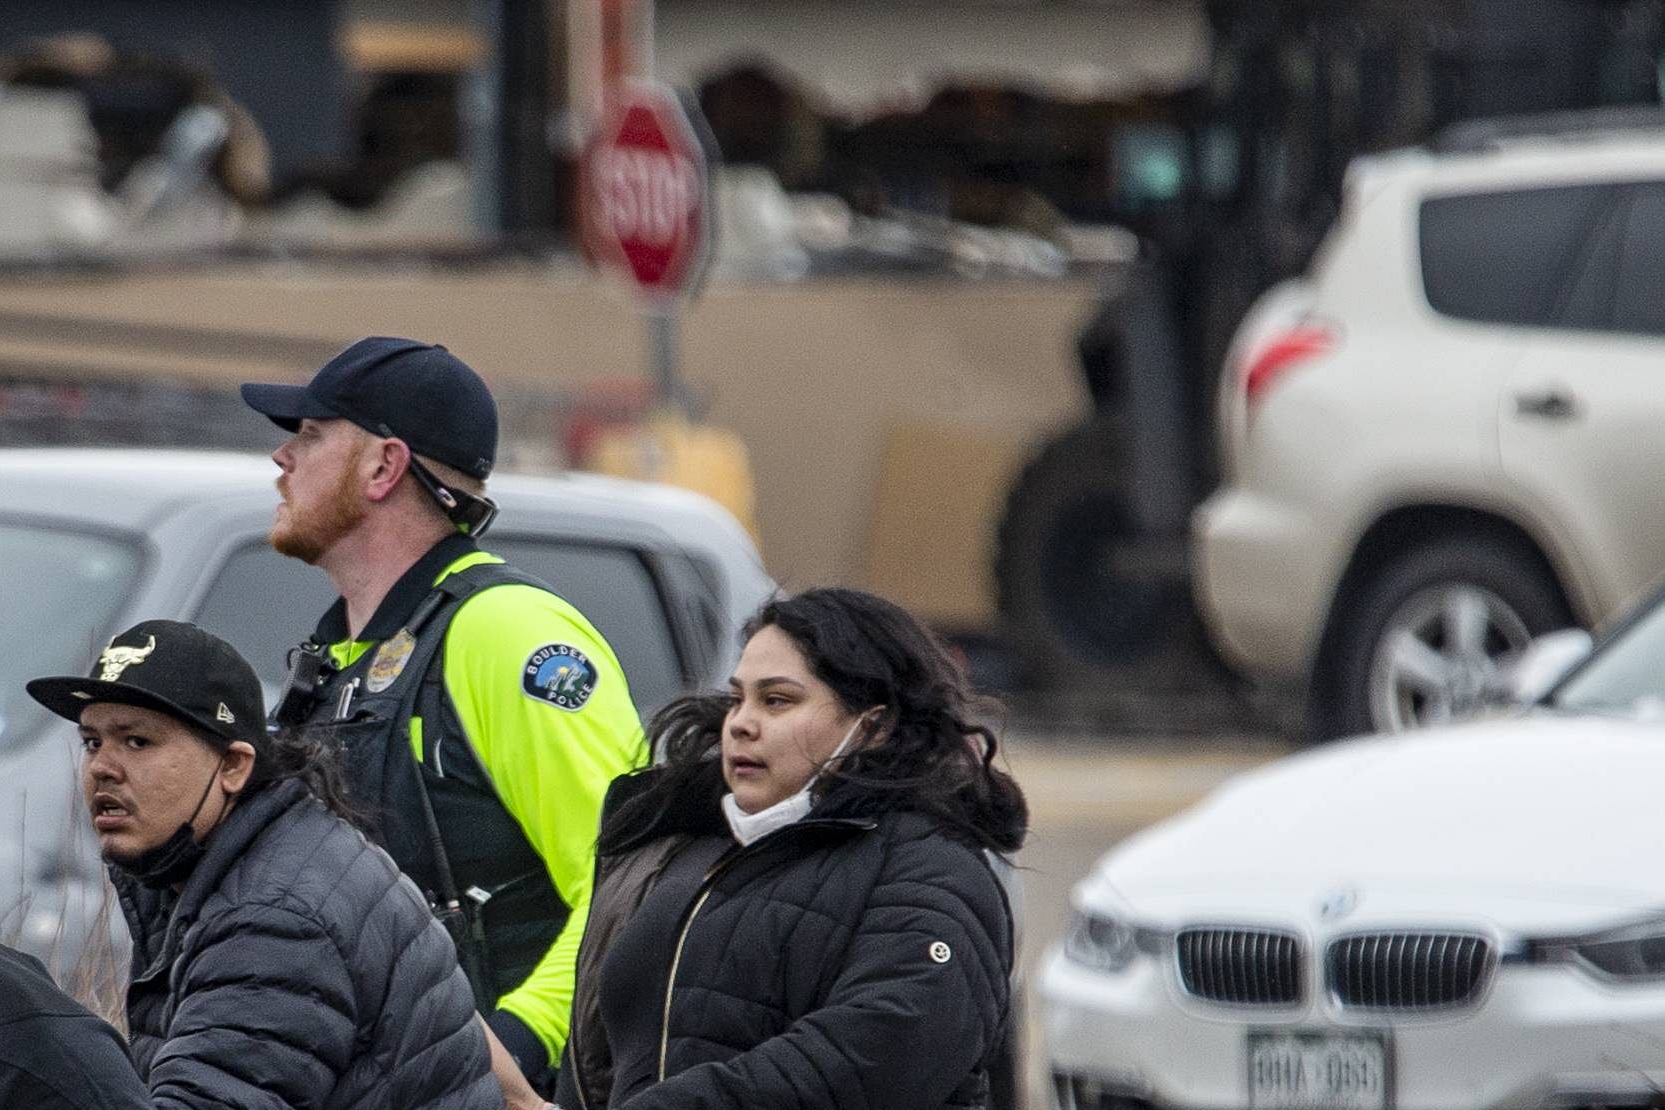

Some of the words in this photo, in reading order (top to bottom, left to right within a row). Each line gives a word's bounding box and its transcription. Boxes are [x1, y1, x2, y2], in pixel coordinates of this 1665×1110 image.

[597, 150, 693, 236] STOP
[527, 645, 587, 675] BOULDER
[548, 683, 592, 708] POLICE
